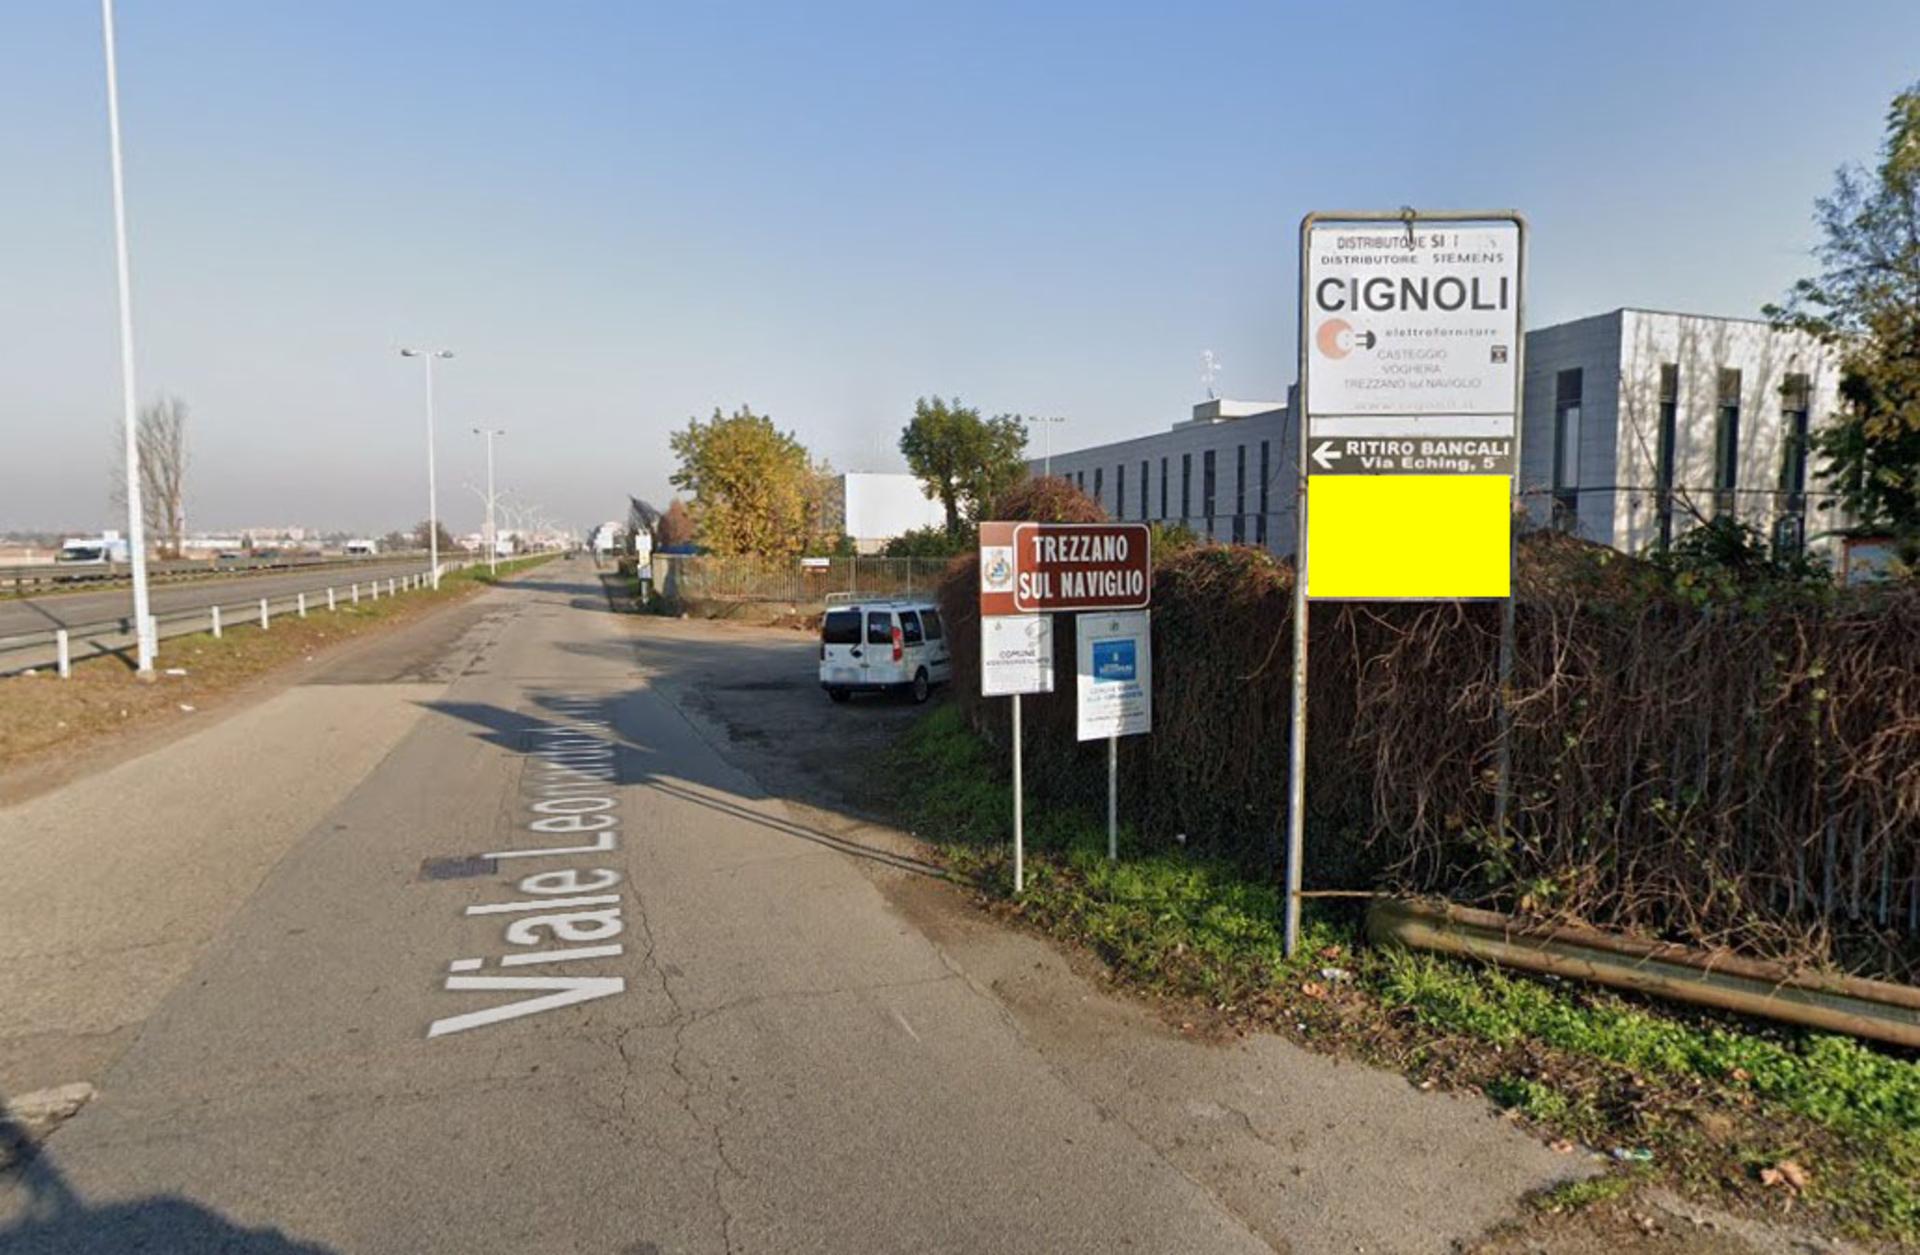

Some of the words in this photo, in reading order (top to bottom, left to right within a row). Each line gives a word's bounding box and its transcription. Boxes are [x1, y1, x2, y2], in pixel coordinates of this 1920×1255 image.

[1321, 254, 1419, 266] DISTRIBUTORE
[1432, 253, 1504, 264] SIEMENS
[1316, 276, 1508, 313] CIGNOLI
[1385, 326, 1497, 338] elettroforniture
[1377, 349, 1447, 361] CASTEGGIO
[1382, 365, 1441, 375] VOGHERA
[1344, 379, 1405, 390] TREZZANO
[1426, 378, 1482, 389] NAVIGLIO
[1346, 441, 1415, 455] RITIRO
[1421, 441, 1509, 456] BANCALI
[1361, 456, 1394, 469] Via
[1401, 456, 1476, 471] Eching,
[1483, 456, 1495, 469] 5
[1032, 535, 1129, 564] TREZZANO
[1018, 571, 1054, 600] SUL
[1060, 569, 1144, 598] NAVIGLIO
